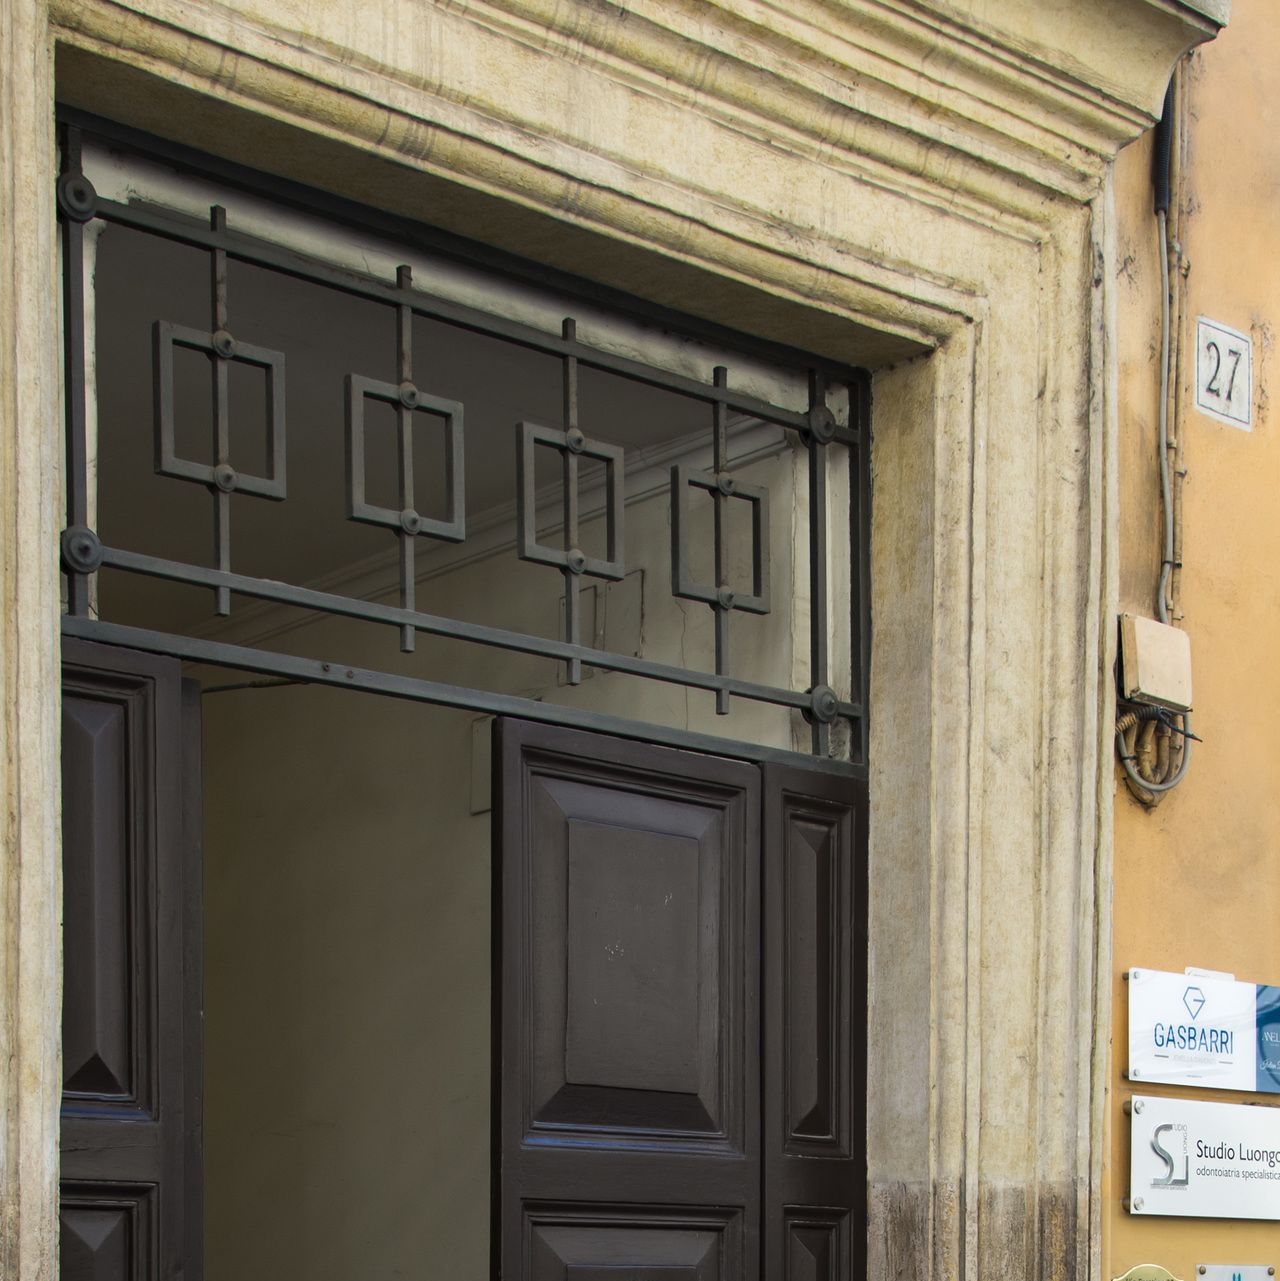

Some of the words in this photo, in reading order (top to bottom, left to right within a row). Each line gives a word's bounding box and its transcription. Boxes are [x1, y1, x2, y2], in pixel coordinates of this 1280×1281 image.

[1205, 341, 1242, 402] 27
[1153, 1022, 1234, 1055] GASBARRI
[1196, 1139, 1236, 1161] Studio
[1195, 1165, 1240, 1178] odontoiatria
